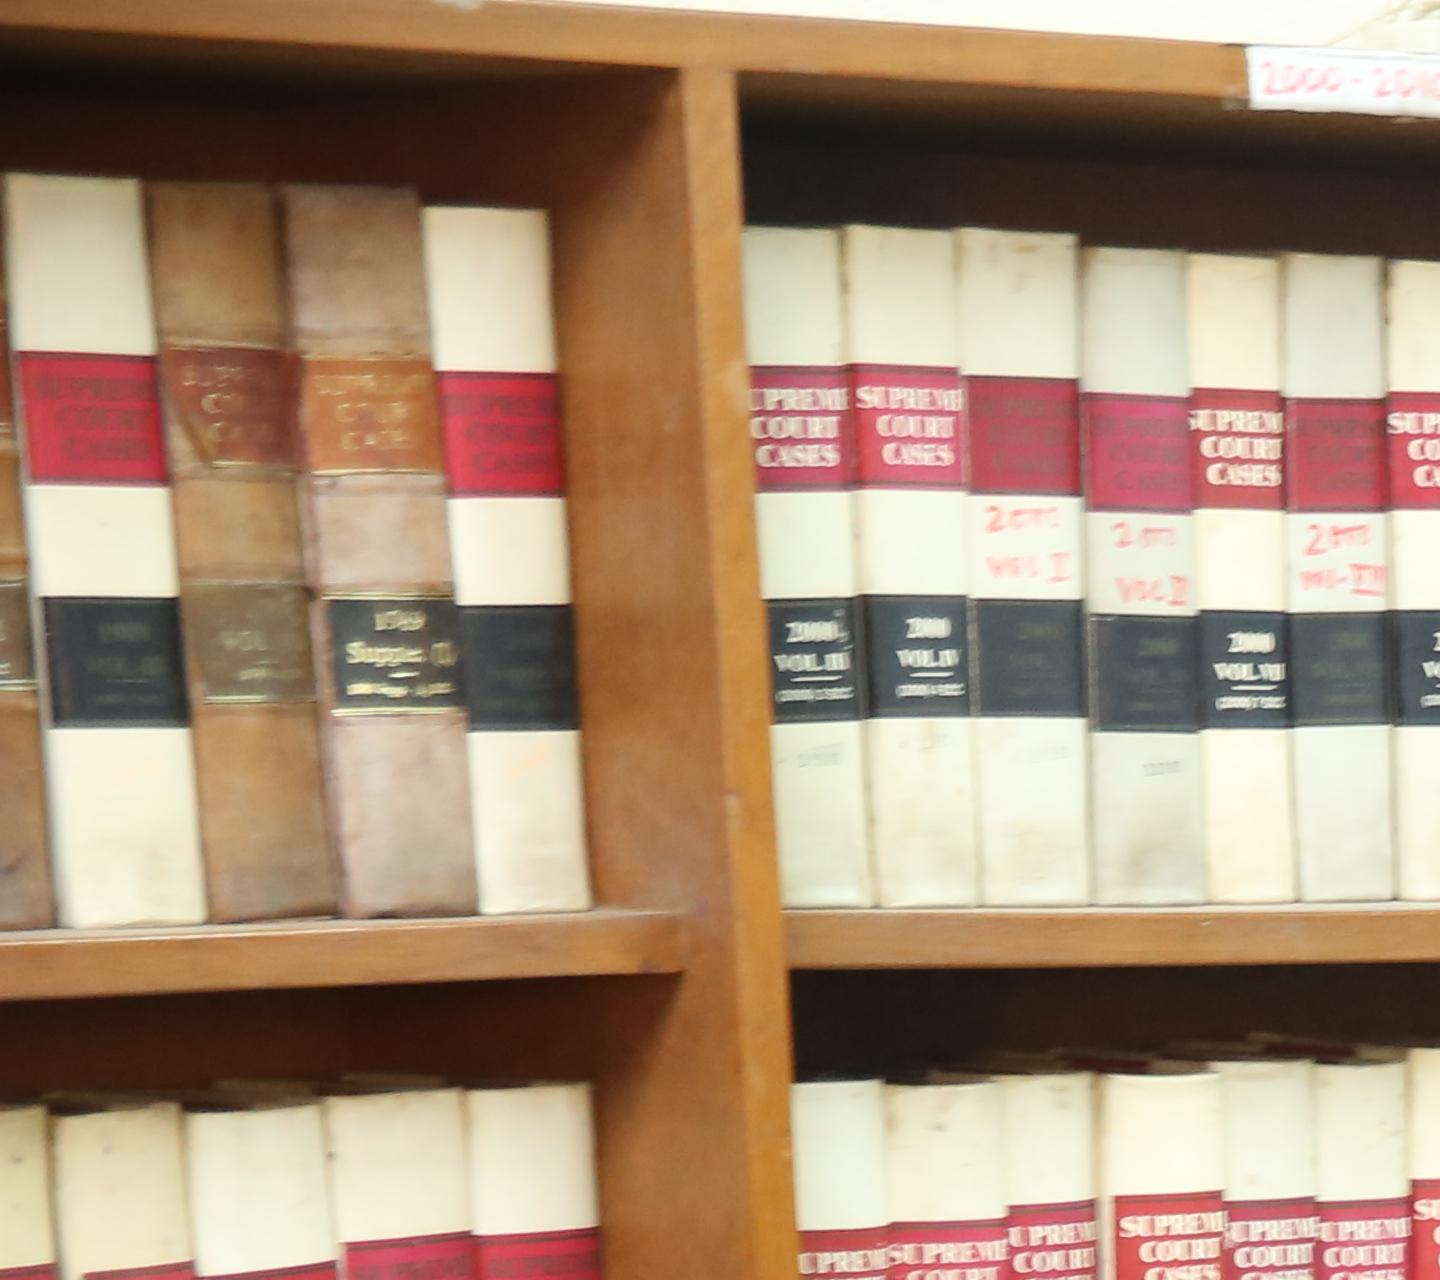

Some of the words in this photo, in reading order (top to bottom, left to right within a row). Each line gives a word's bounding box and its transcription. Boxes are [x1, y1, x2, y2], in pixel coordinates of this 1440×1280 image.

[750, 416, 842, 439] COURT
[875, 415, 955, 438] COURT
[755, 443, 841, 467] CASES
[882, 443, 955, 467] CASES
[1200, 437, 1283, 460] COURT
[1206, 463, 1282, 487] CASES
[1012, 1247, 1096, 1273] COURT
[1139, 1238, 1221, 1263] COURT
[1234, 1243, 1314, 1268] COURT
[1323, 1241, 1407, 1268] COURT
